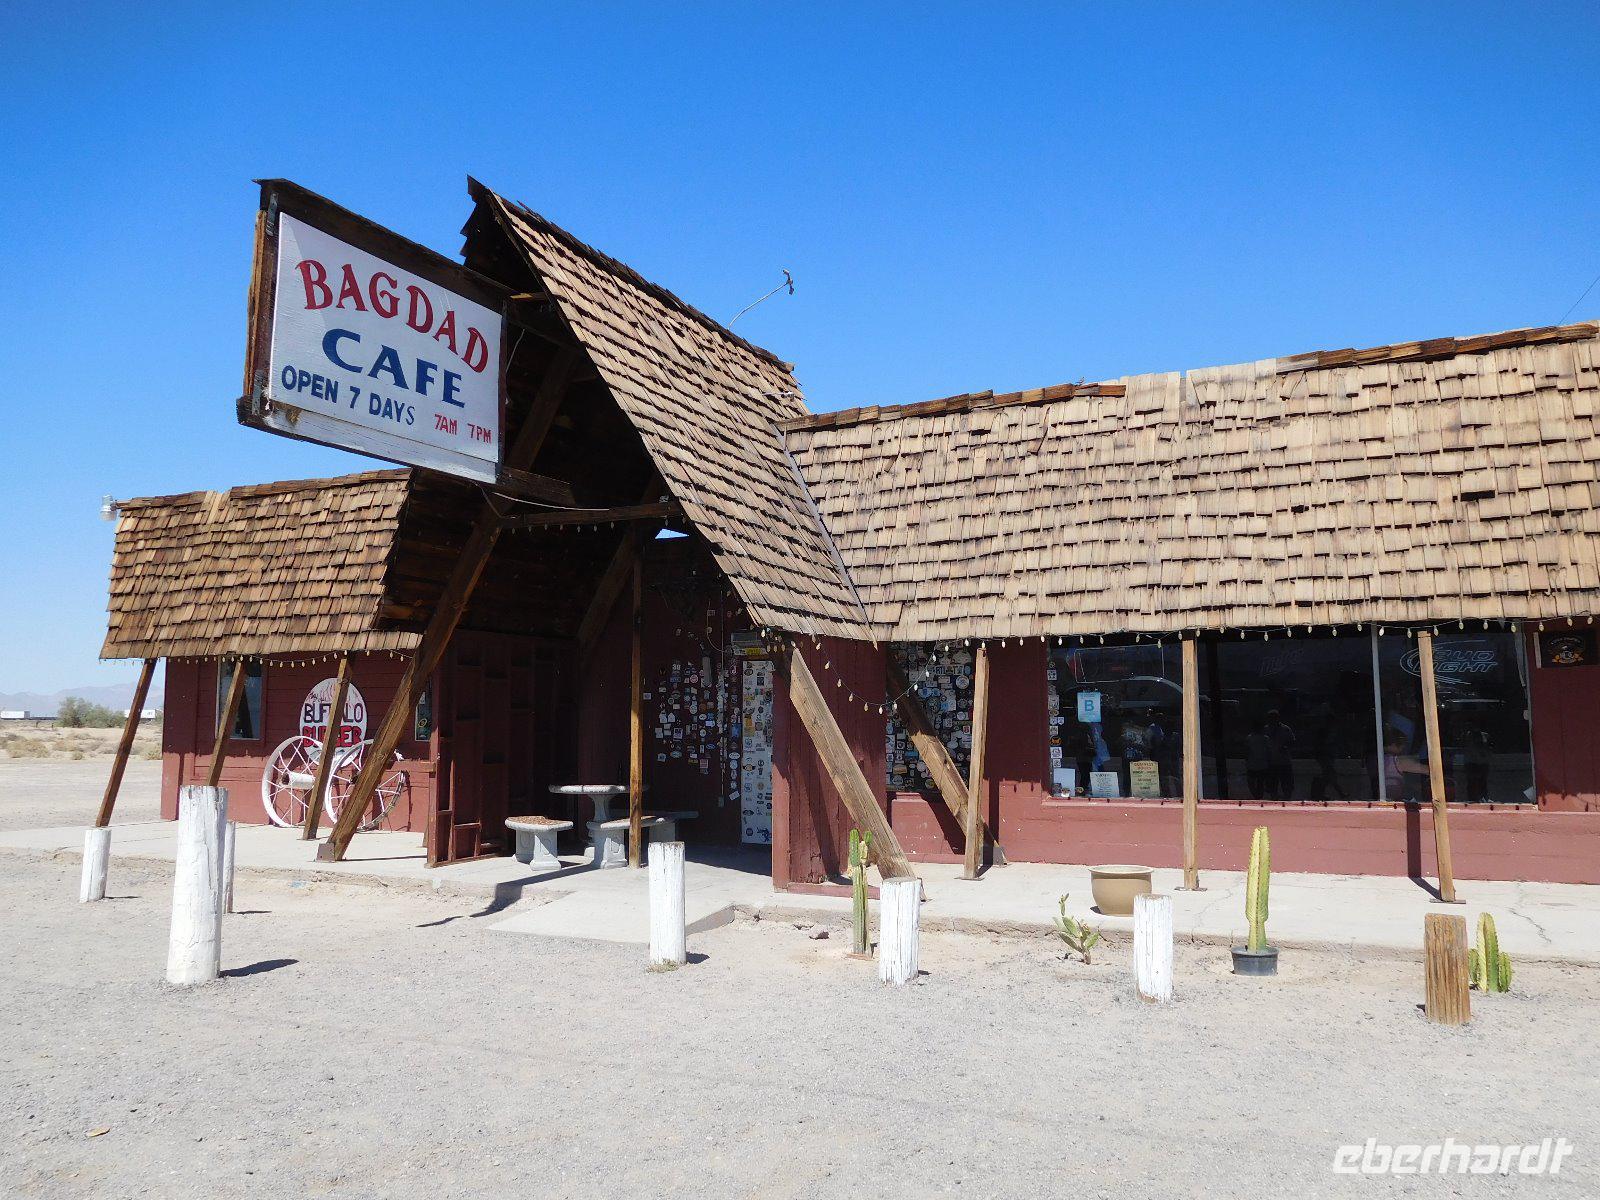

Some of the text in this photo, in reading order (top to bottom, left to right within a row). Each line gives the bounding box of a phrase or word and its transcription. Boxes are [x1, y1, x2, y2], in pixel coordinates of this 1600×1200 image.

[295, 259, 489, 373] BAGDAD
[322, 328, 465, 408] CAFE
[281, 365, 416, 426] OPEN 7 DAYS
[434, 413, 492, 444] 7AM 7PM
[1412, 661, 1498, 673] GHT
[1433, 650, 1495, 662] BUD
[303, 702, 364, 723] BUFLO
[1084, 699, 1095, 712] B
